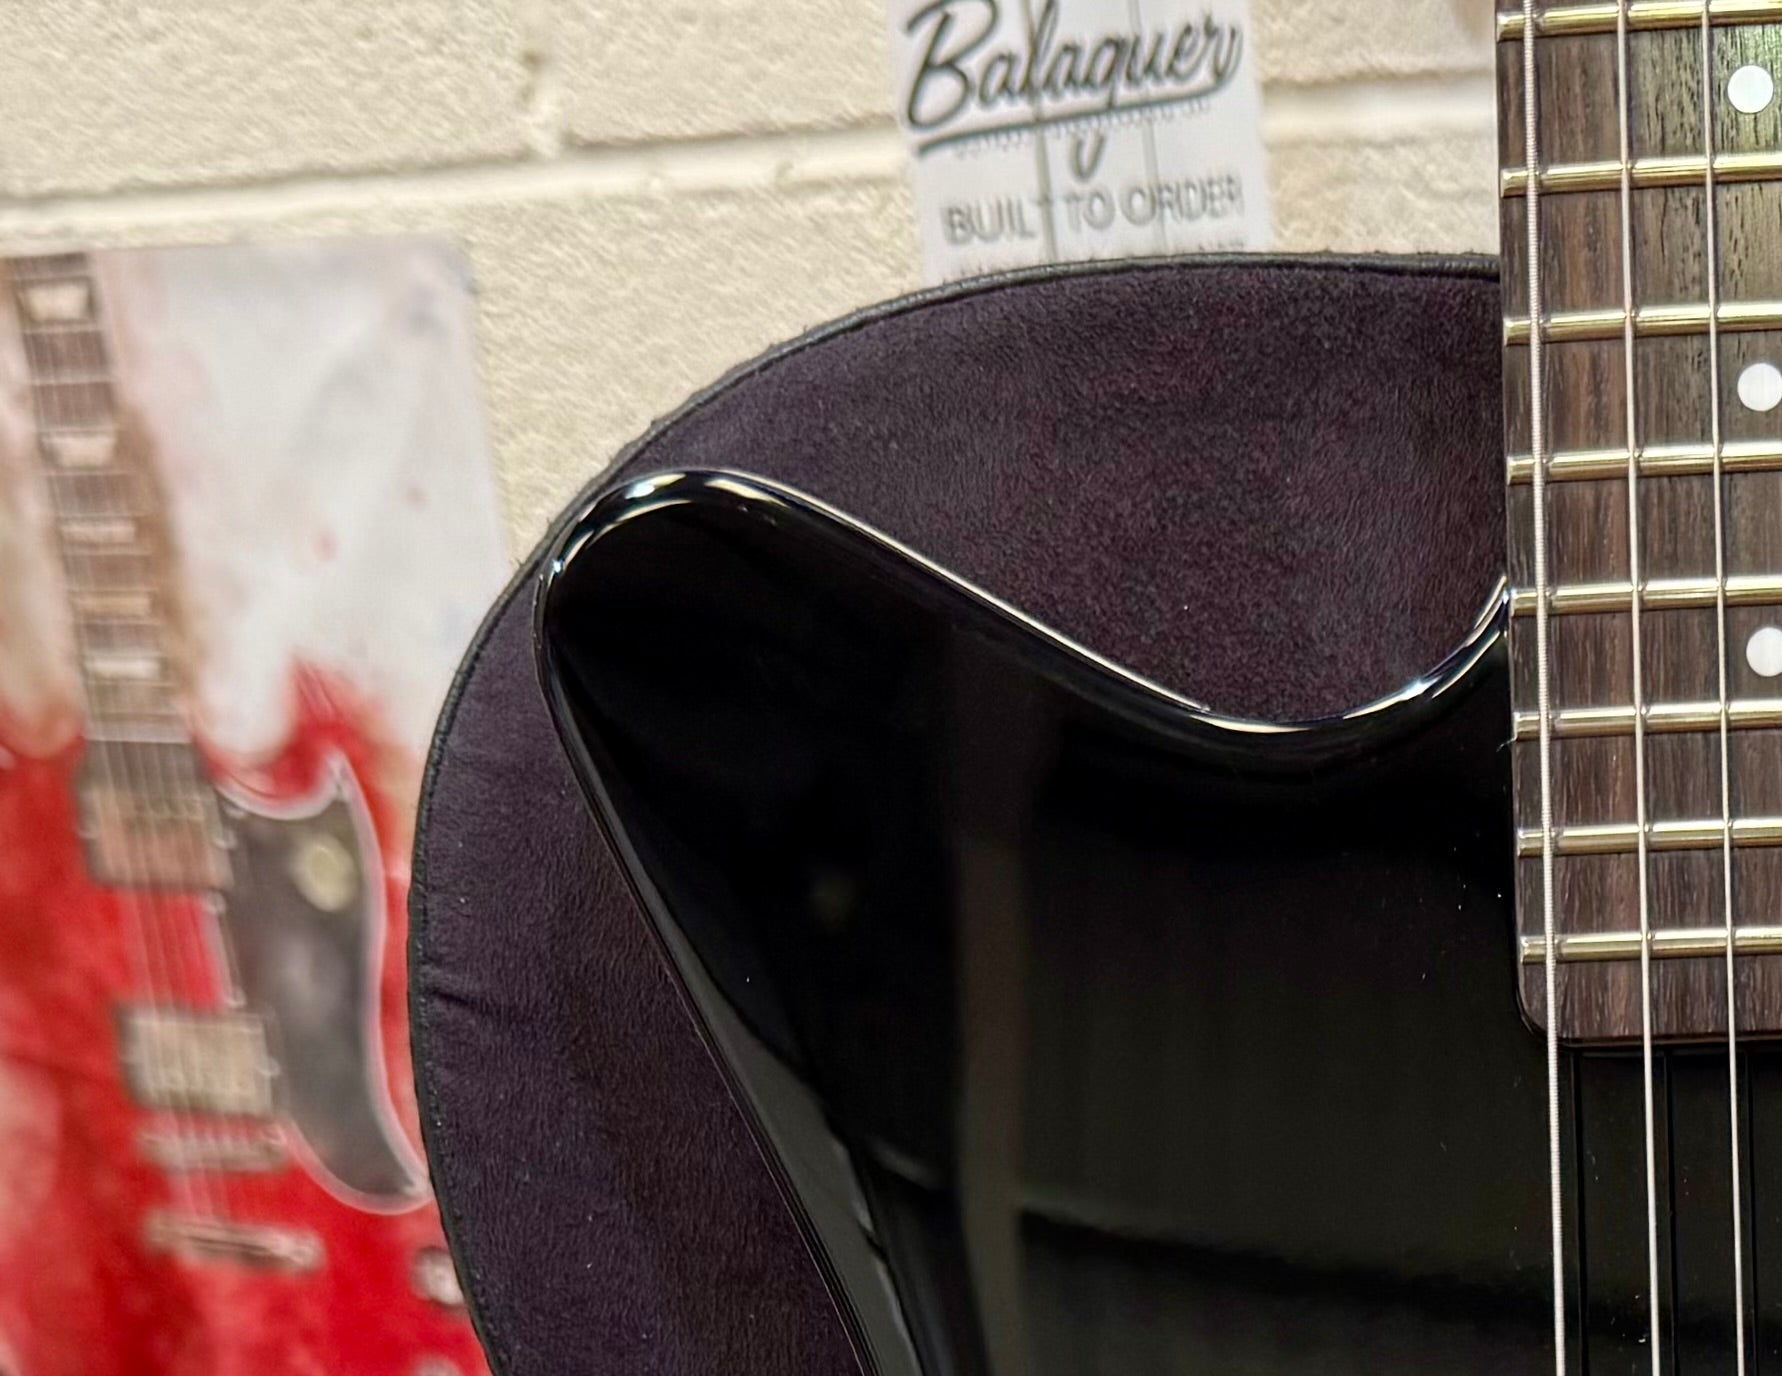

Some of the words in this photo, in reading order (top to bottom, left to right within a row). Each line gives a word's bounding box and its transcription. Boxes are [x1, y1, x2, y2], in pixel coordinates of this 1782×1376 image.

[906, 0, 1243, 179] Balaguer
[1062, 186, 1116, 233] TO
[1120, 173, 1245, 228] ORDER
